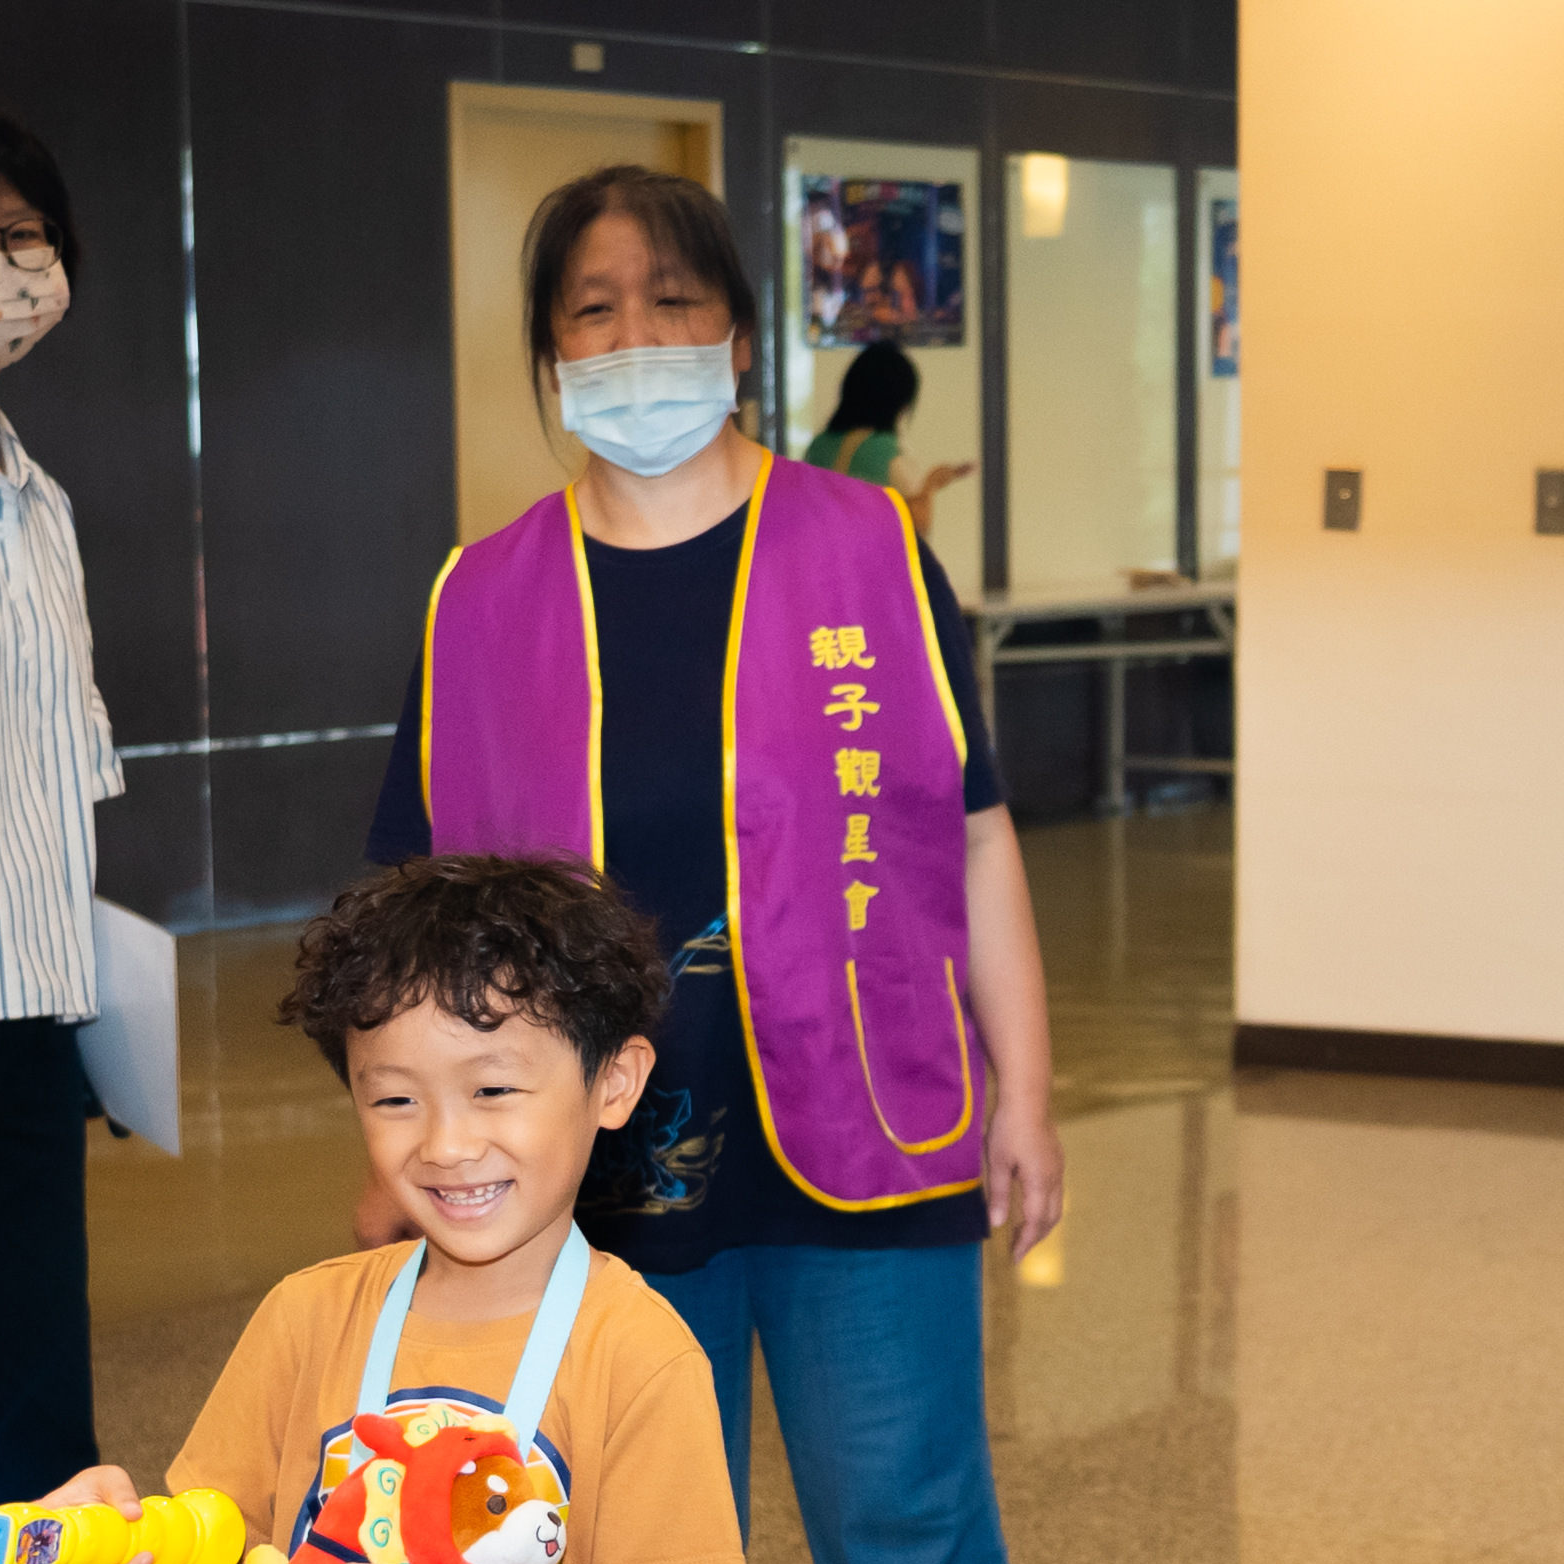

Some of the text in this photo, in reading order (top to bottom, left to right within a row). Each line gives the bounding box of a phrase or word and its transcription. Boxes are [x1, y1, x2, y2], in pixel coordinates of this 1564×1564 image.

[809, 625, 882, 932] 親子觀星會
